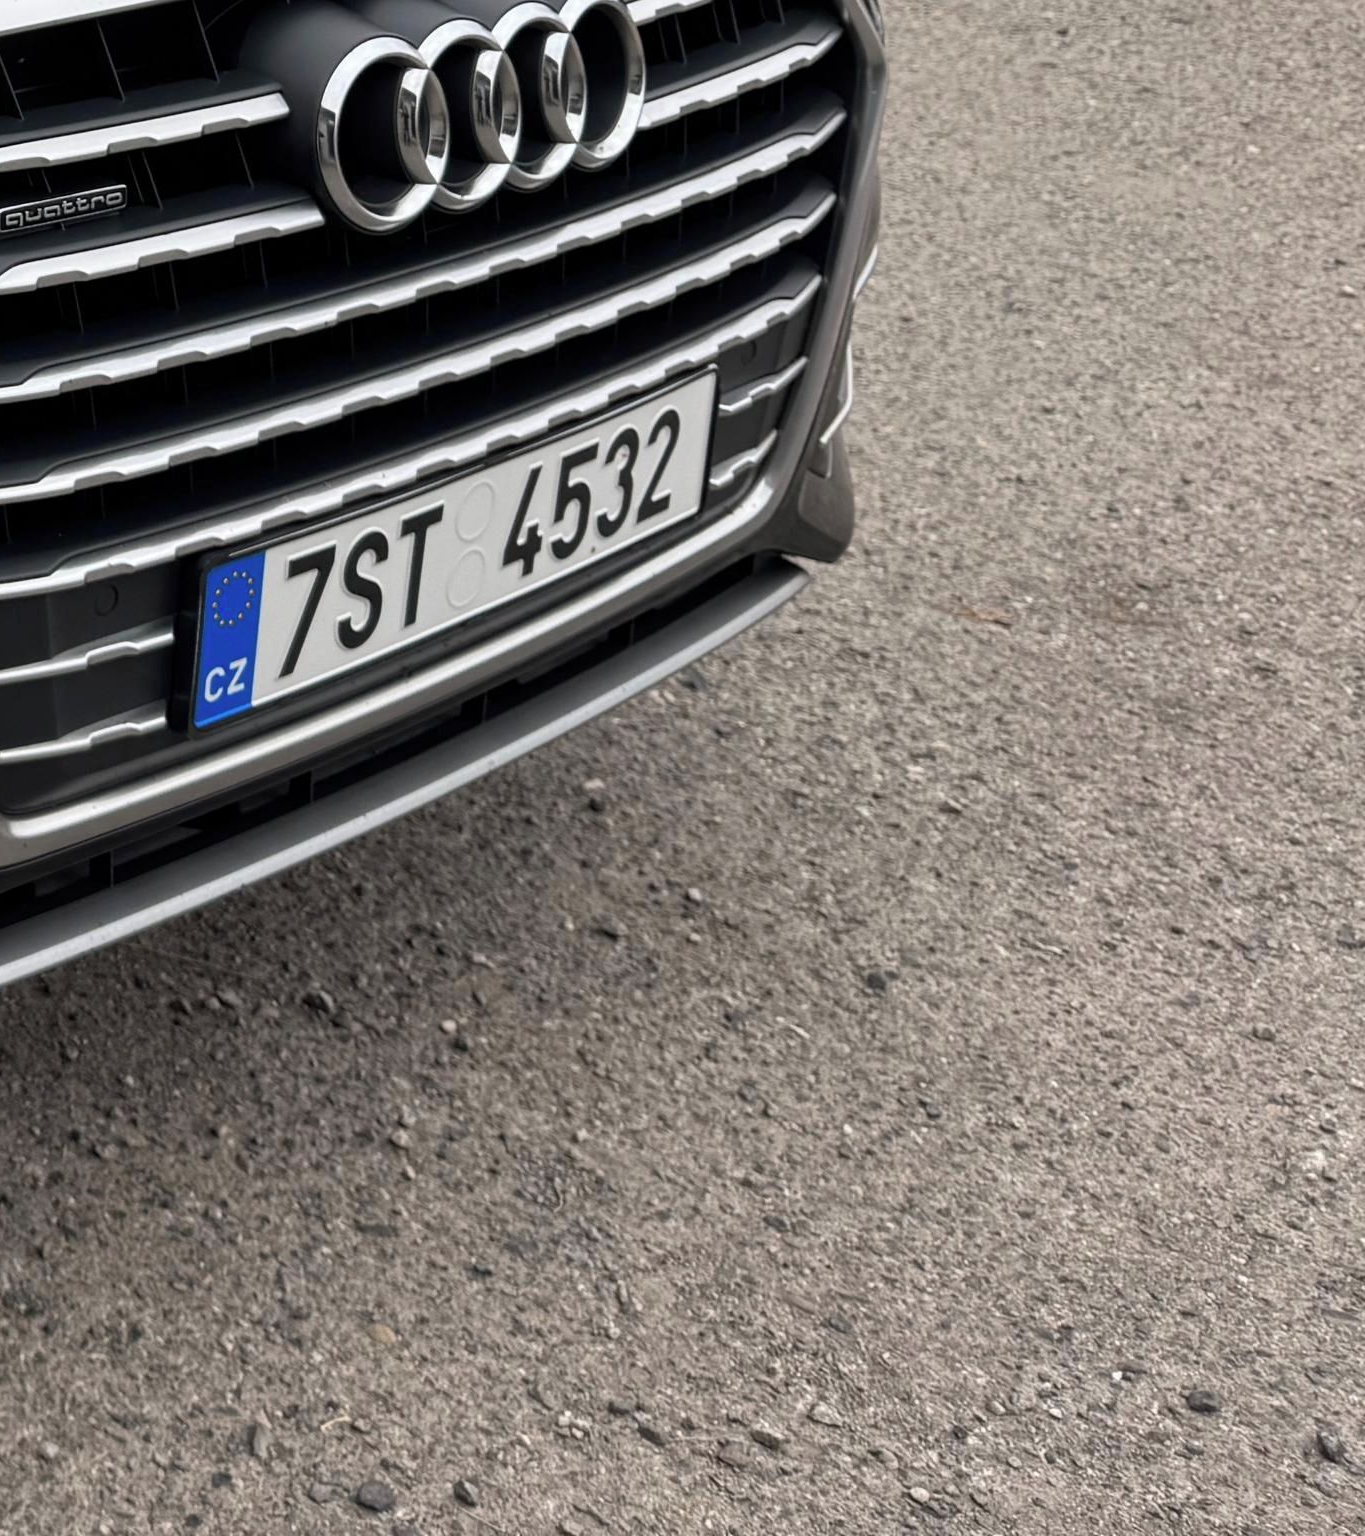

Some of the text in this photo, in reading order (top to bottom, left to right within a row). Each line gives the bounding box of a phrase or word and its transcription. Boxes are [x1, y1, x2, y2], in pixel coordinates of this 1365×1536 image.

[5, 192, 123, 227] quattro
[278, 409, 681, 679] 7ST 4532
[204, 657, 247, 703] CZ
